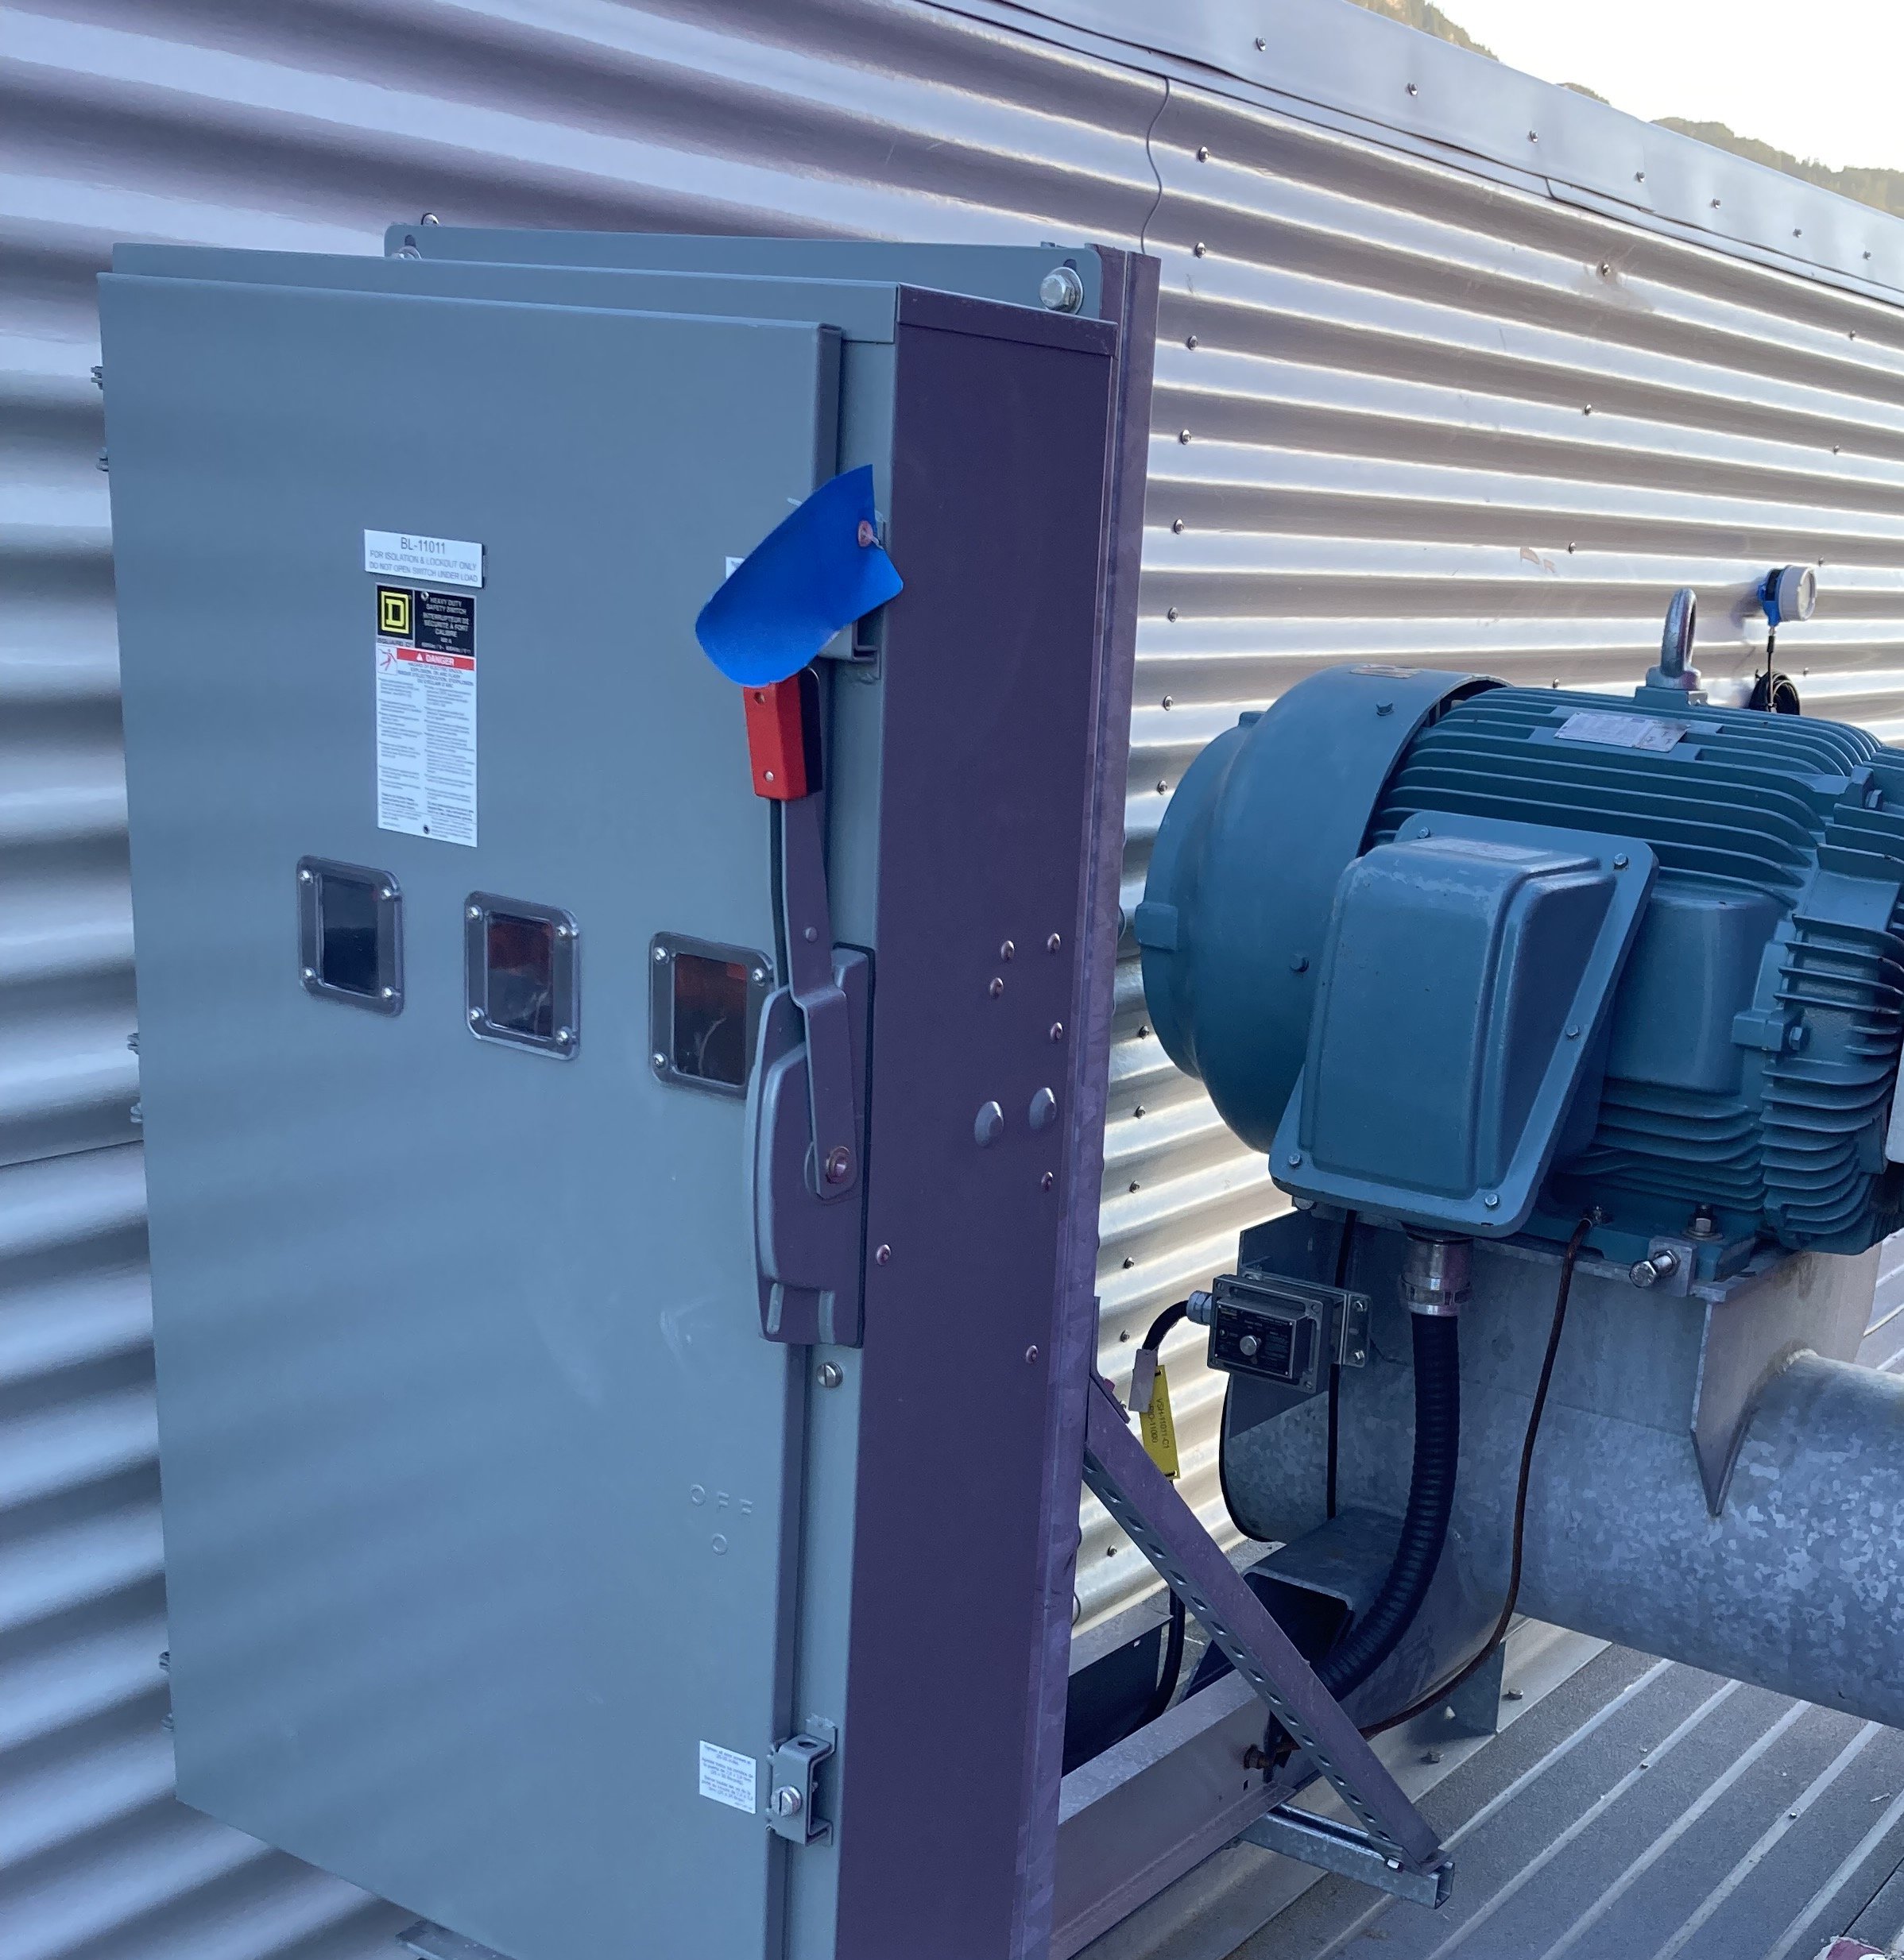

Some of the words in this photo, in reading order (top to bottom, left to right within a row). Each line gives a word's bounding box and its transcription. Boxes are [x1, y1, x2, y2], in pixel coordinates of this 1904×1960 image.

[401, 537, 446, 555] BL-11011
[370, 550, 383, 559] FOR
[385, 551, 419, 563] ISOLATION
[426, 557, 457, 569] LOCKOUT
[459, 561, 477, 571] ONLY
[379, 562, 392, 571] NOT
[393, 564, 410, 574] OPEN
[412, 567, 437, 578] SWITCH
[438, 570, 459, 581] UNDER
[461, 574, 478, 582] LOAD
[426, 655, 455, 666] DANGER
